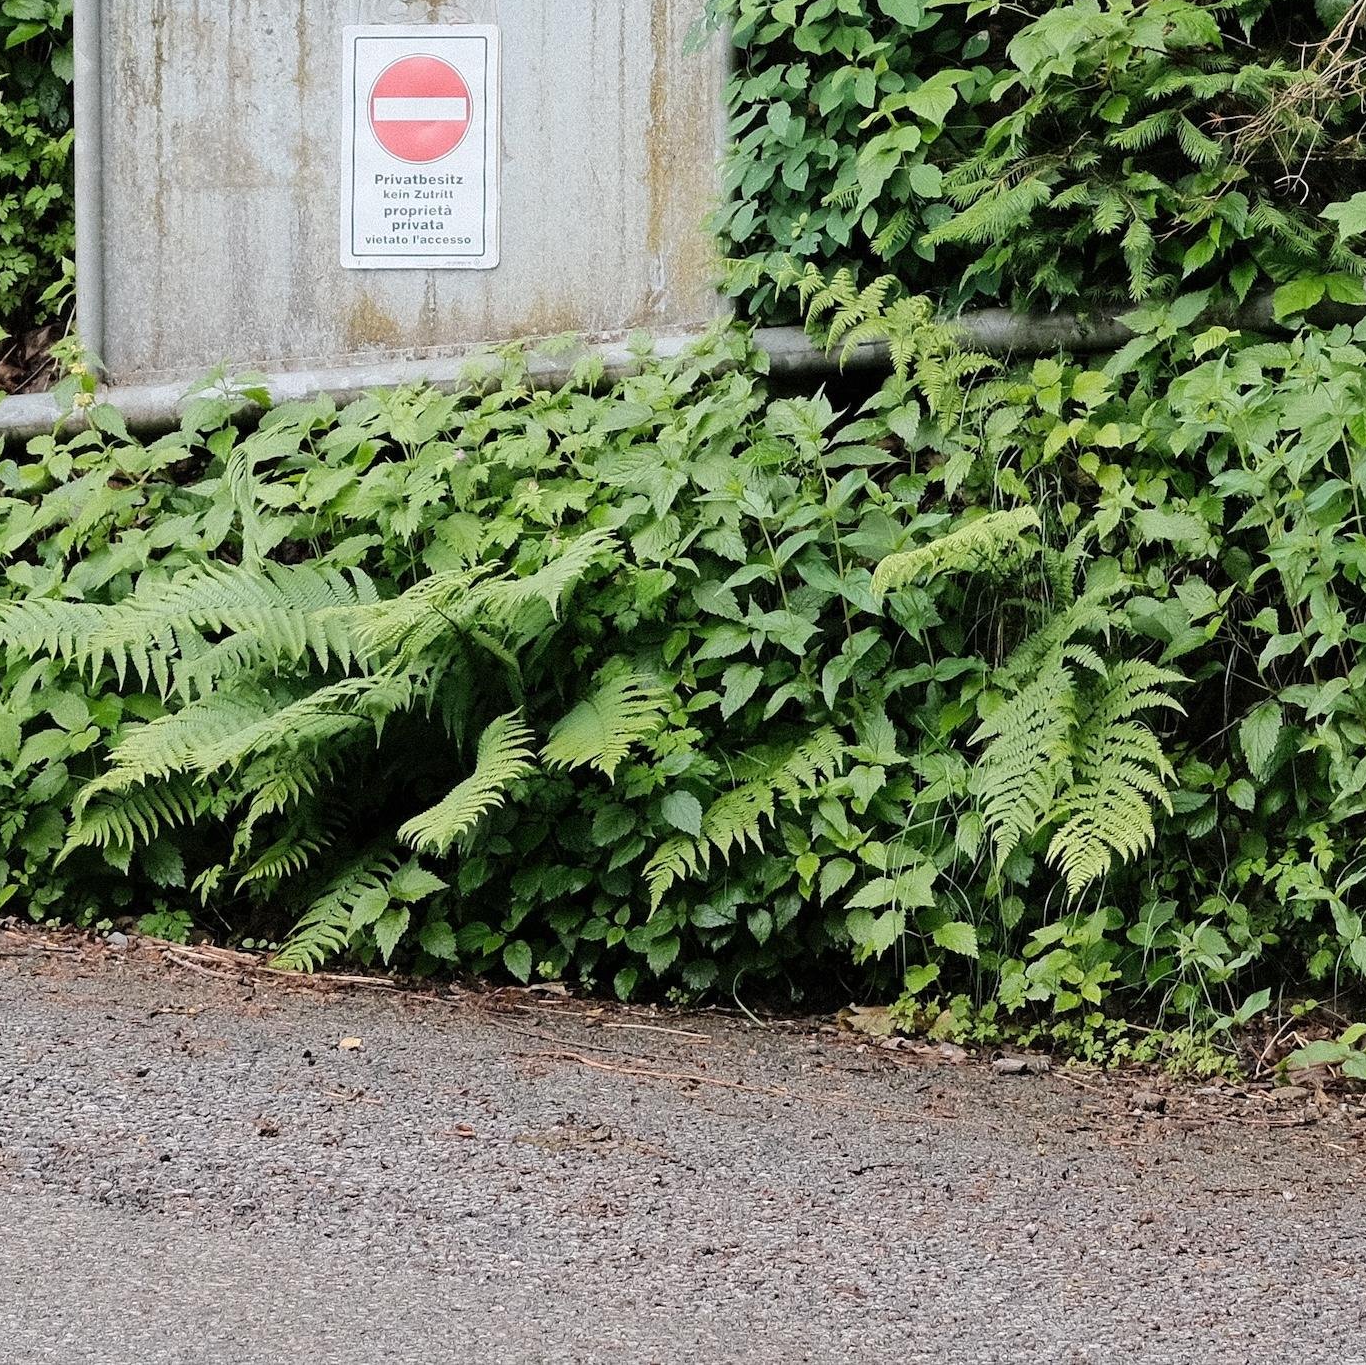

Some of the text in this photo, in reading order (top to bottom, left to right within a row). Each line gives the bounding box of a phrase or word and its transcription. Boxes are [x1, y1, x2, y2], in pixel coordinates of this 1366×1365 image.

[374, 173, 464, 185] Privatbesitz
[383, 190, 454, 199] kein Zutritt
[384, 204, 452, 218] proprietà
[392, 219, 444, 232] privata
[365, 235, 472, 244] vietato l'accesso
